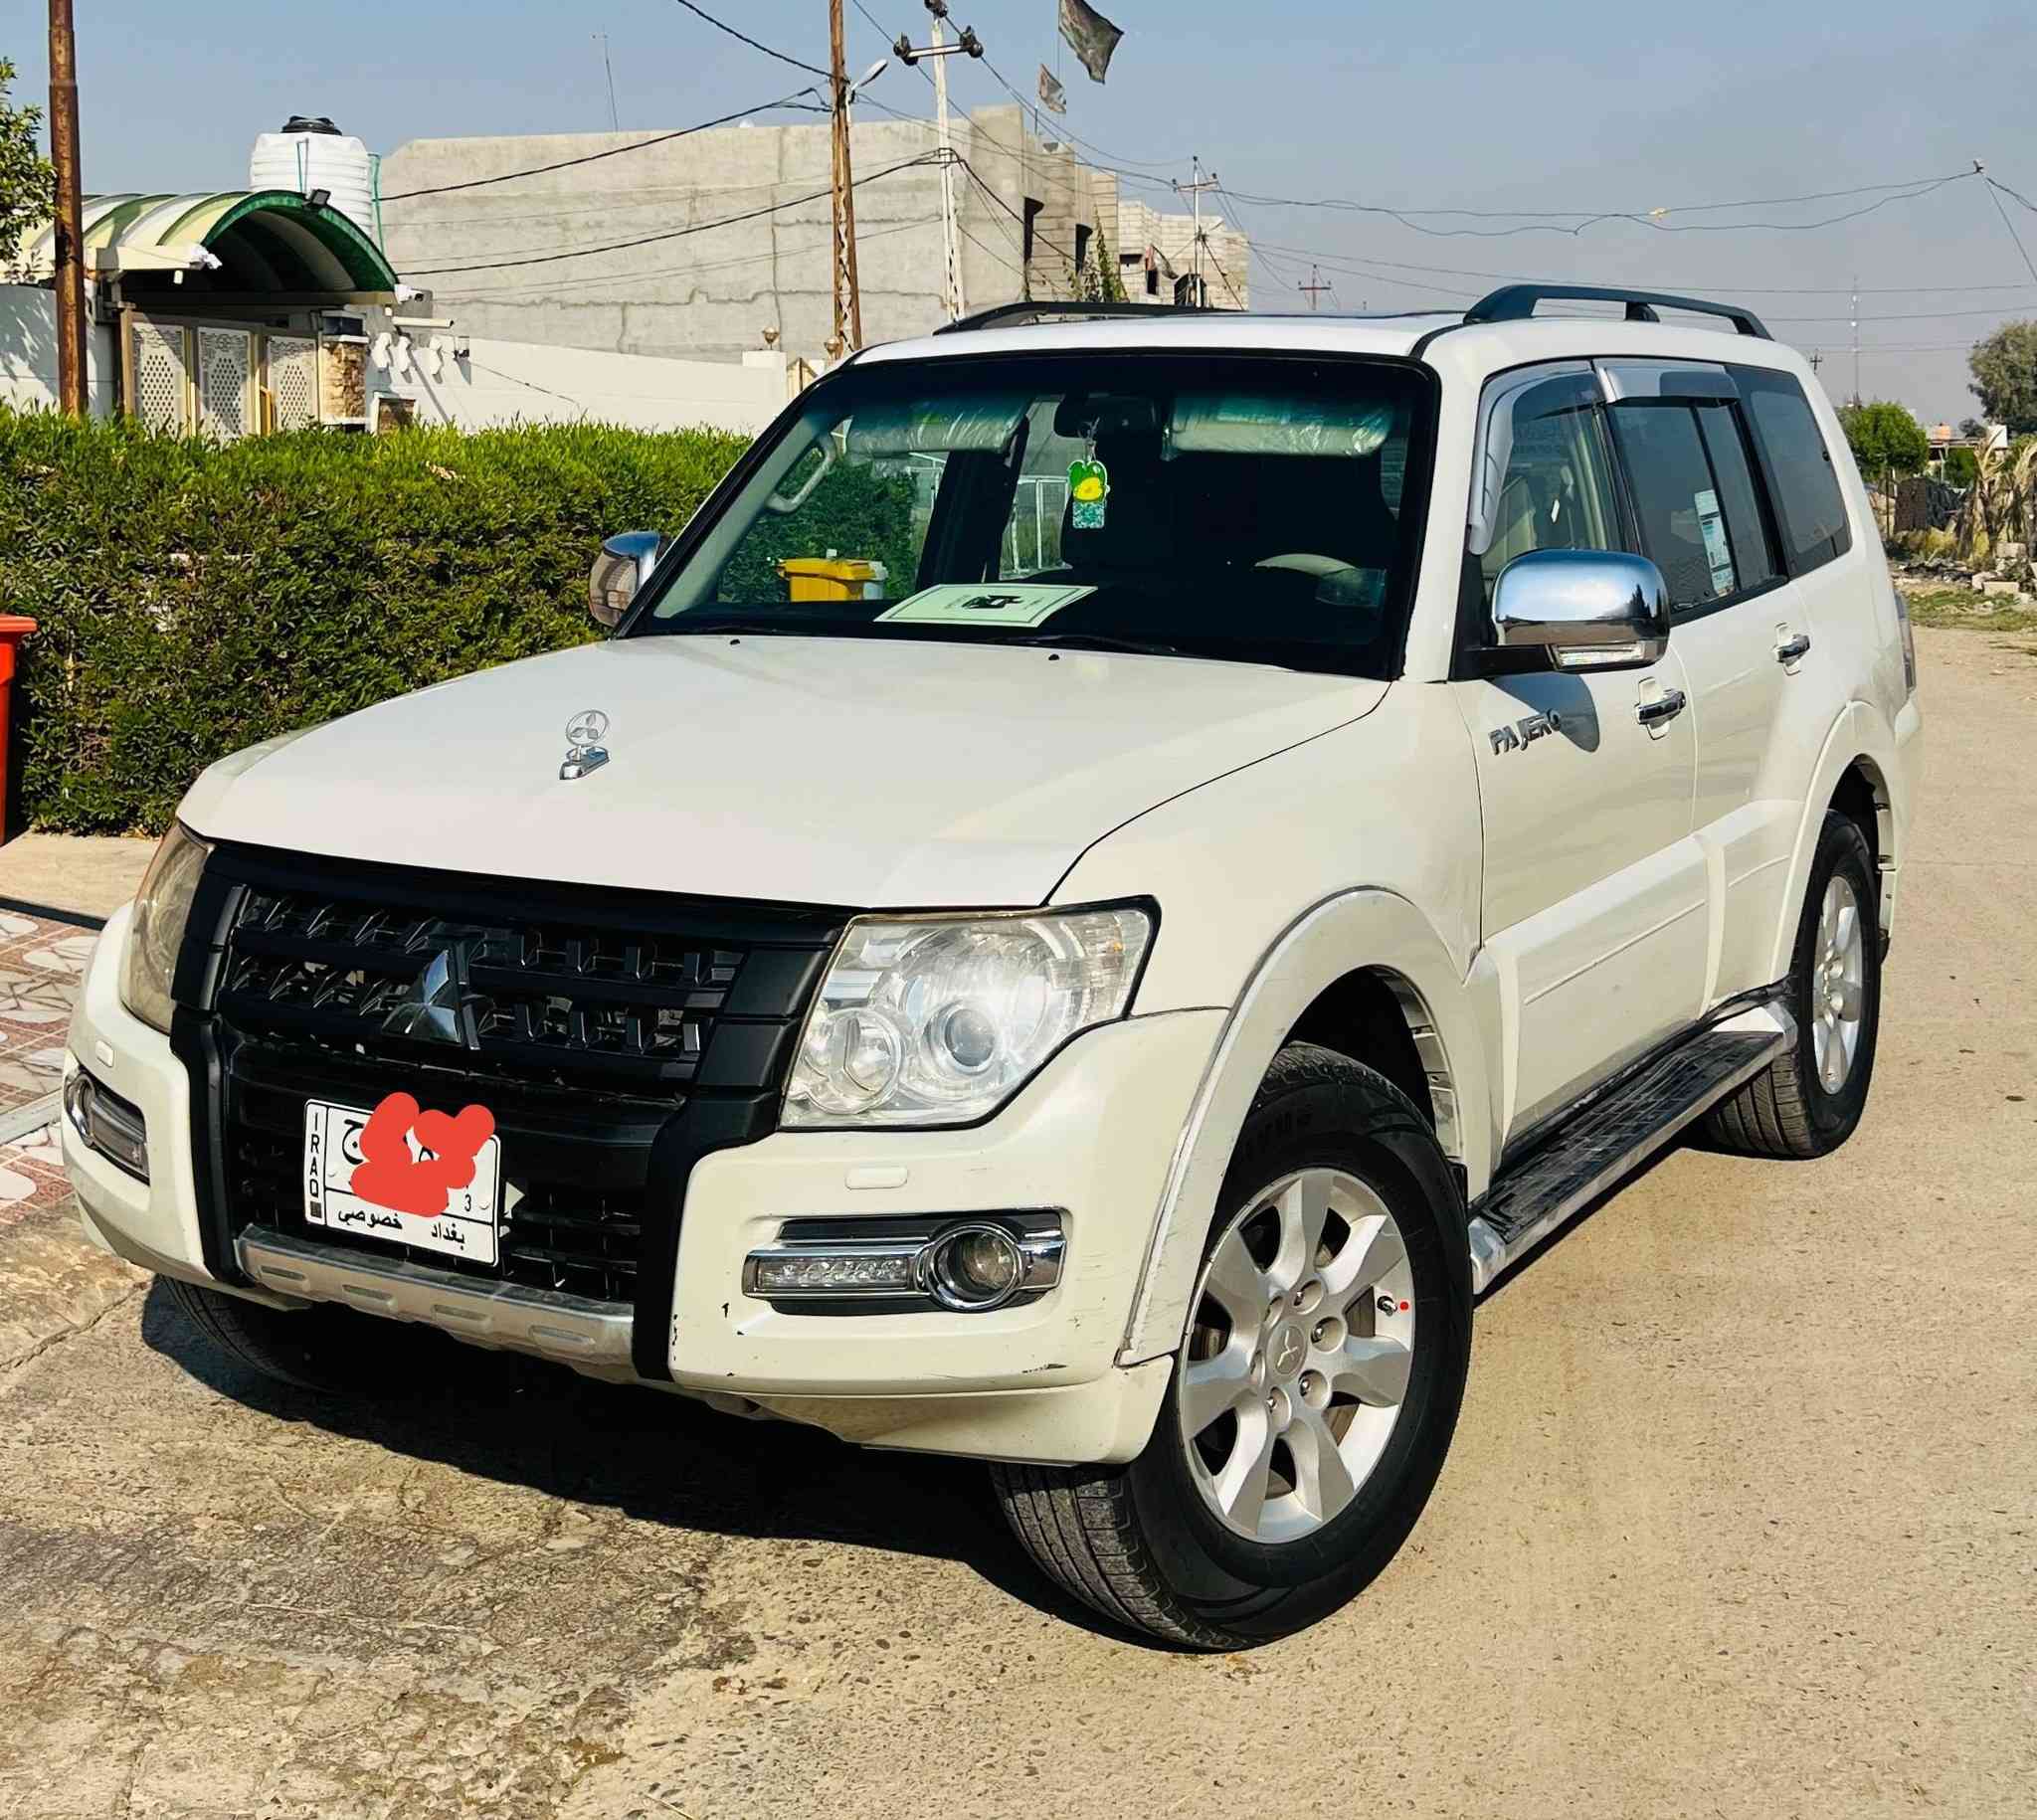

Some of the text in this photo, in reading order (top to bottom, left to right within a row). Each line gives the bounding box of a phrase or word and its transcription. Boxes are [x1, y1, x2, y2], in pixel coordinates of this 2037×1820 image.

[1488, 708, 1561, 755] PAJERO
[309, 1111, 320, 1198] IRAQ
[337, 1208, 466, 1250] بغداد خصوصي
